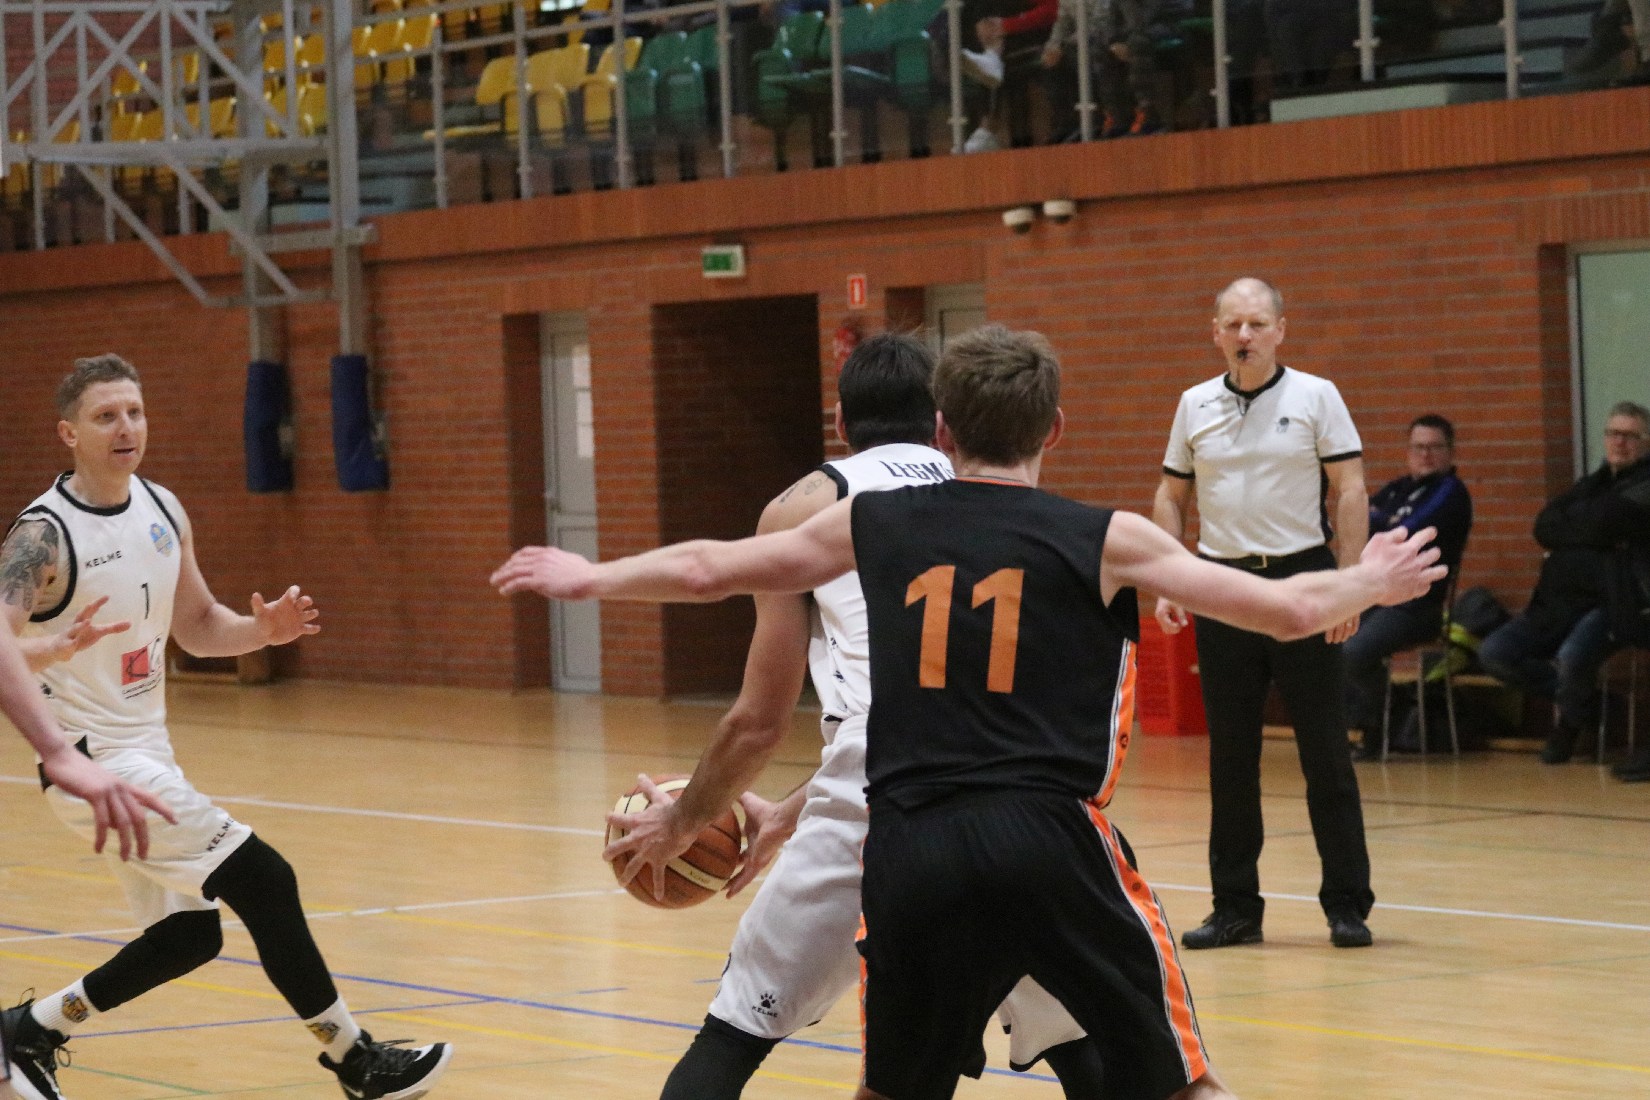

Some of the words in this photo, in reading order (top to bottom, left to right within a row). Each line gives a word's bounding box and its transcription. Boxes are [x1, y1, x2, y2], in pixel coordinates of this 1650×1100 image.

[85, 550, 122, 568] KELME
[141, 582, 150, 620] 1
[905, 564, 1024, 693] 11
[752, 1005, 778, 1018] KELME
